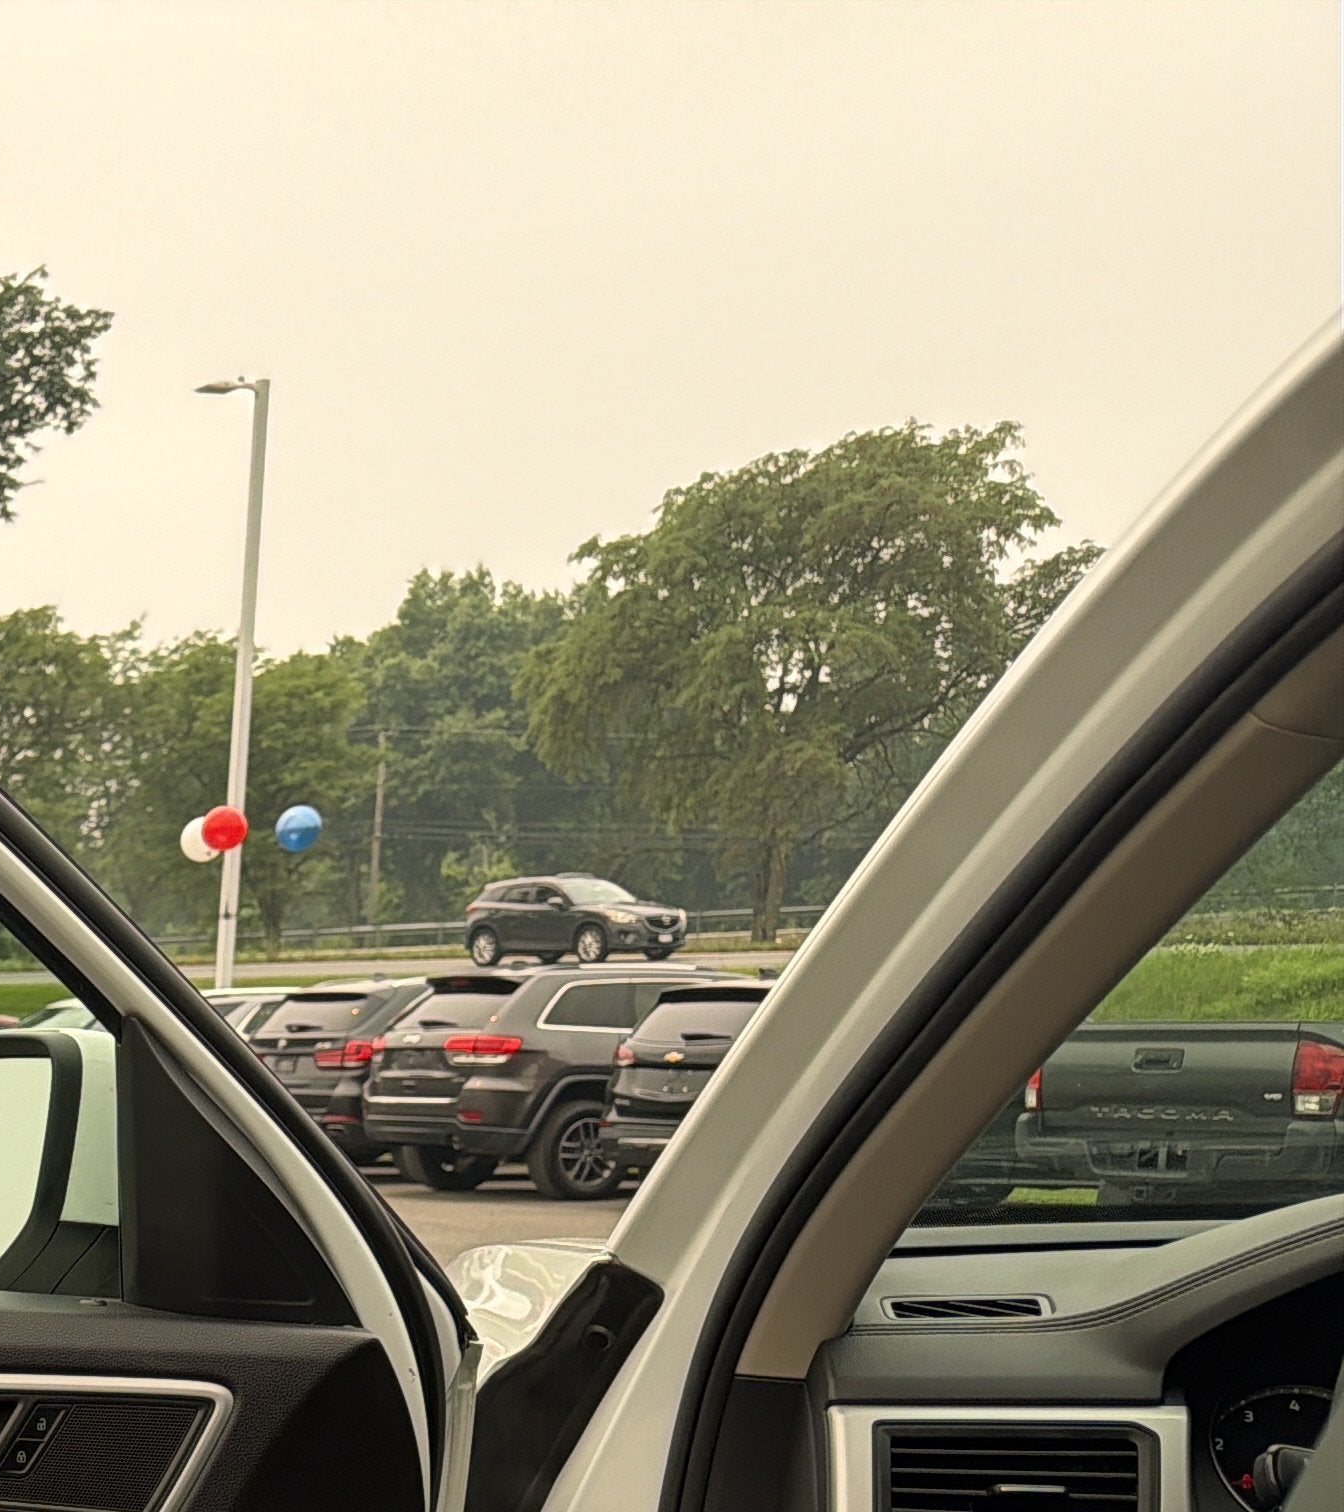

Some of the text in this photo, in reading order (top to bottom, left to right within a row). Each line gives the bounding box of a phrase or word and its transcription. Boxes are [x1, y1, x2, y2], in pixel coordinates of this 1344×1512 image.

[1091, 1106, 1234, 1121] TACOMA
[1289, 1400, 1300, 1412] 4
[1243, 1410, 1254, 1423] 3
[1214, 1438, 1224, 1451] 2
